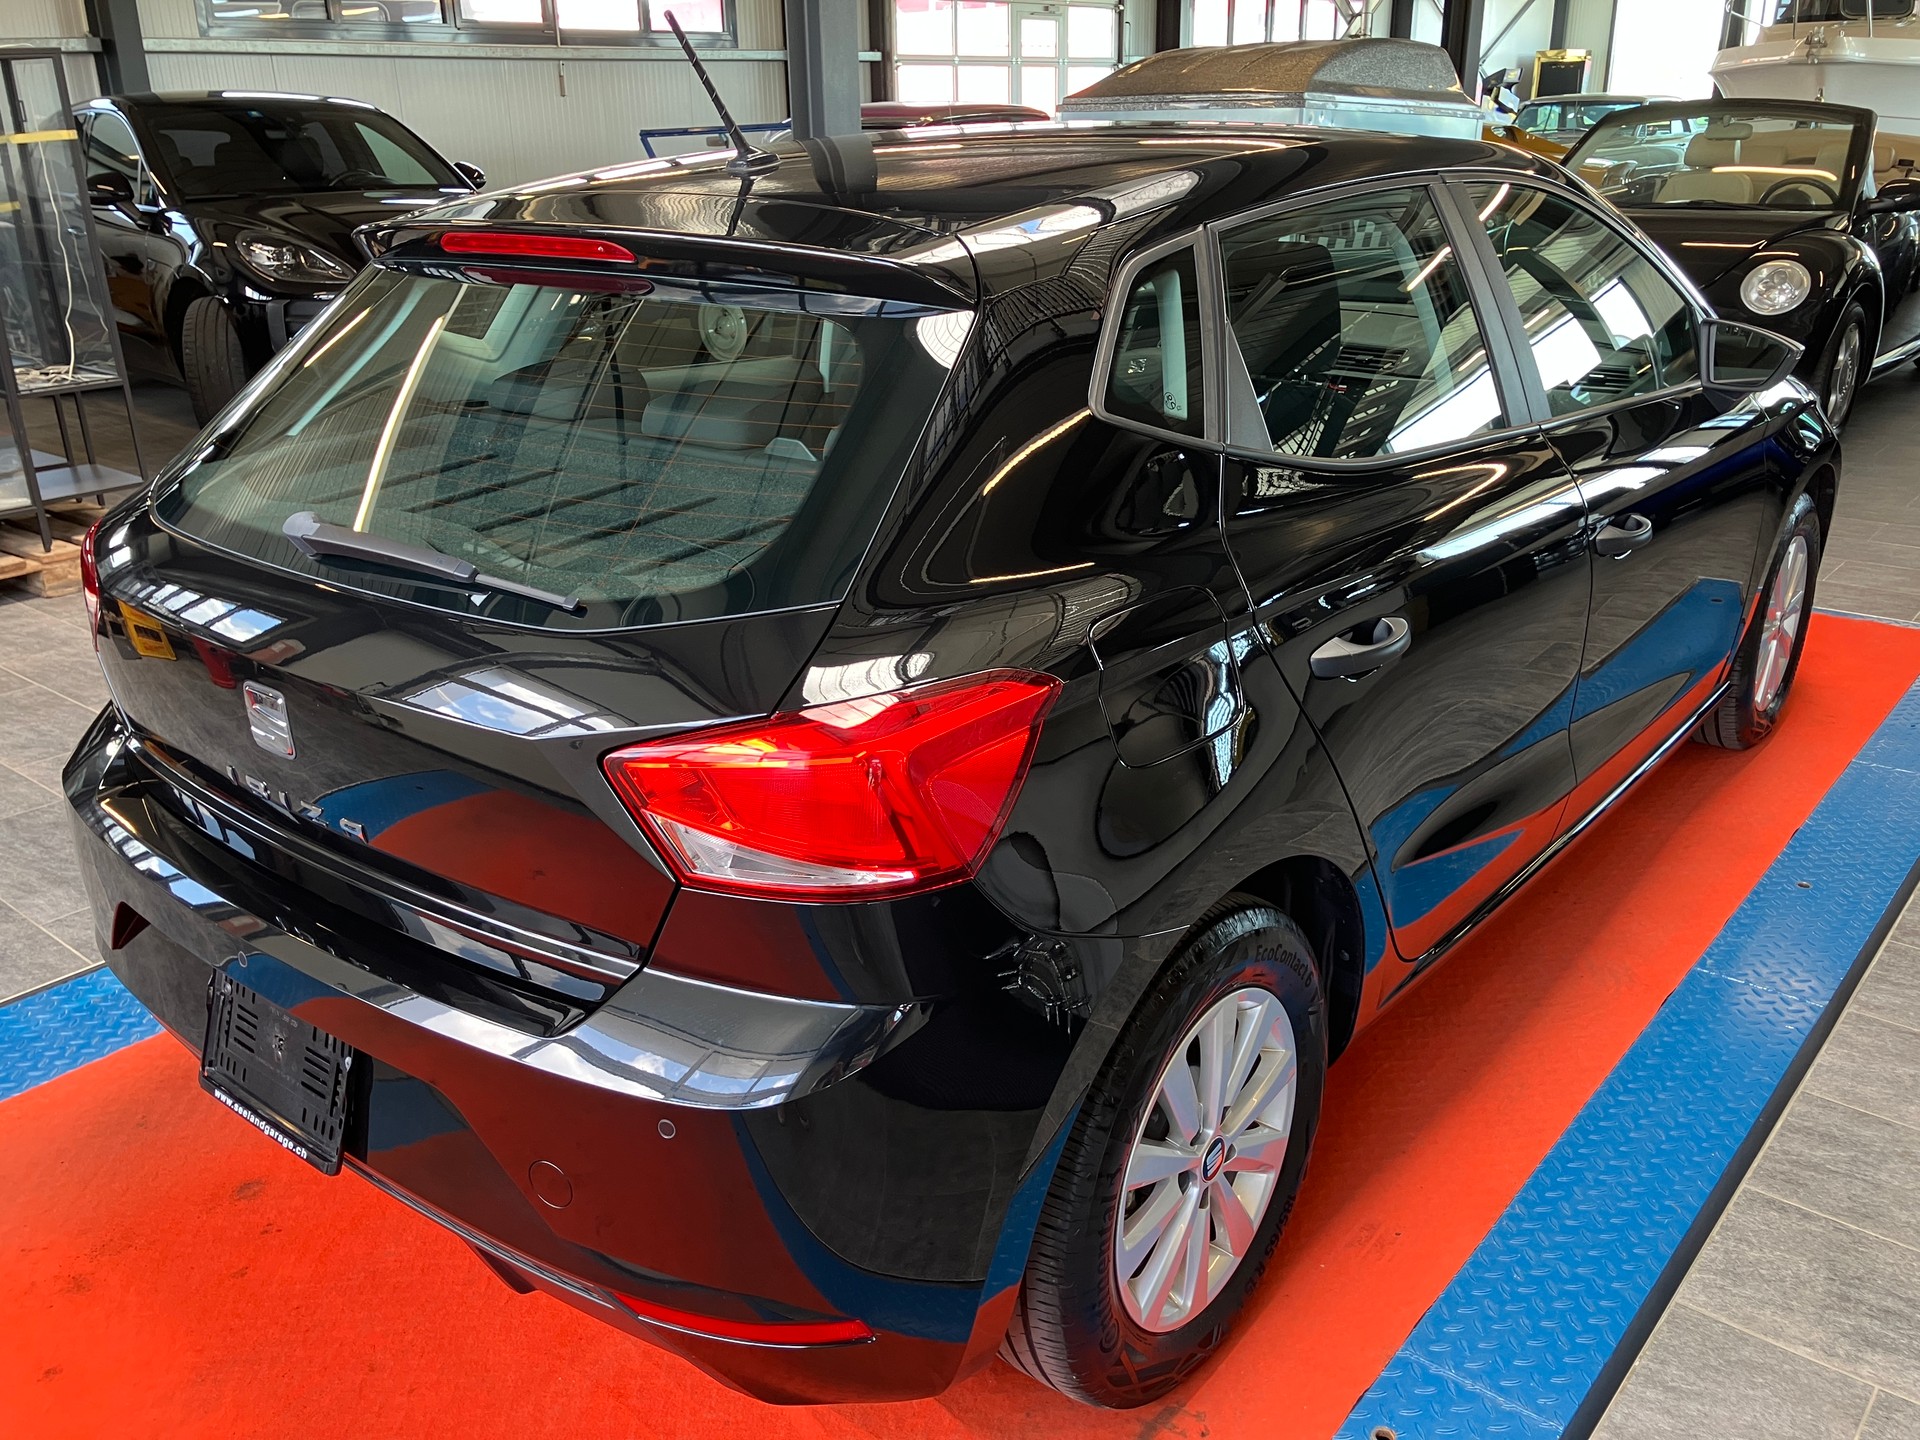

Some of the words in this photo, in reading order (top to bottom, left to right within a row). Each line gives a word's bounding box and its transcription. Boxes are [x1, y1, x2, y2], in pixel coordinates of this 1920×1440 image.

[1254, 944, 1308, 980] EcoContact
[1304, 971, 1313, 988] 6
[214, 1088, 308, 1159] www.seelandgarage.ch
